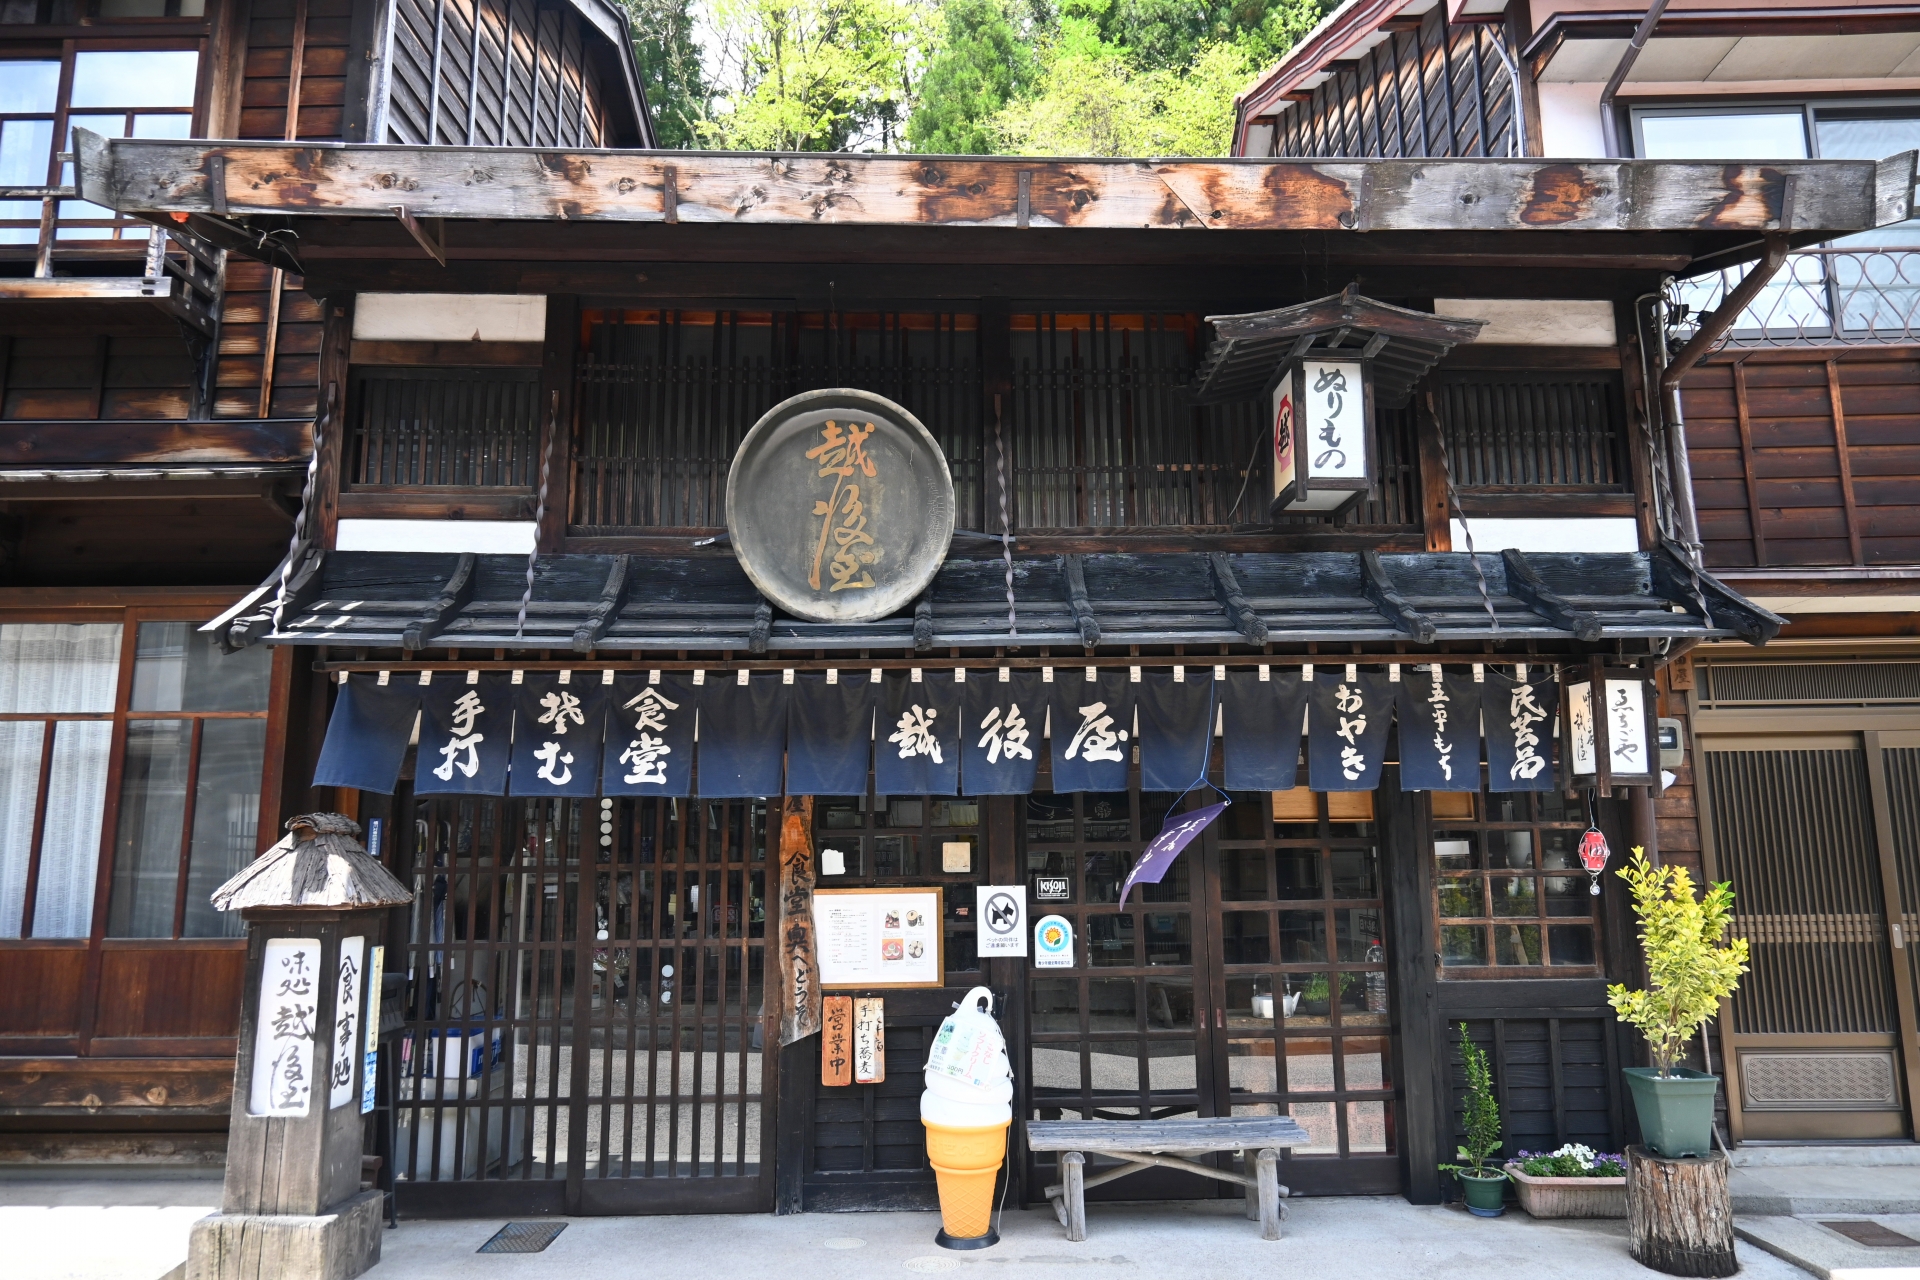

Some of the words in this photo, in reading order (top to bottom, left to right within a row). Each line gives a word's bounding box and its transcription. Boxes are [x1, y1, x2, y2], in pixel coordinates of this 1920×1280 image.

[1313, 367, 1348, 469] ぬりもの
[805, 419, 877, 592] 越後屋
[433, 689, 485, 781] 手打
[619, 687, 679, 784] 食堂
[888, 702, 1128, 764] 越後屋
[1335, 684, 1367, 780] おやき
[1427, 682, 1452, 781] 五平もち
[1510, 684, 1547, 781] 民芸品
[1611, 688, 1638, 763] ゑちごや
[1040, 880, 1066, 893] KISOJI
[331, 955, 358, 1090] 食事処
[828, 1008, 846, 1075] 営業中
[857, 1005, 872, 1074] 手打ち蕎麦
[963, 1031, 986, 1079] ソフトクリーム
